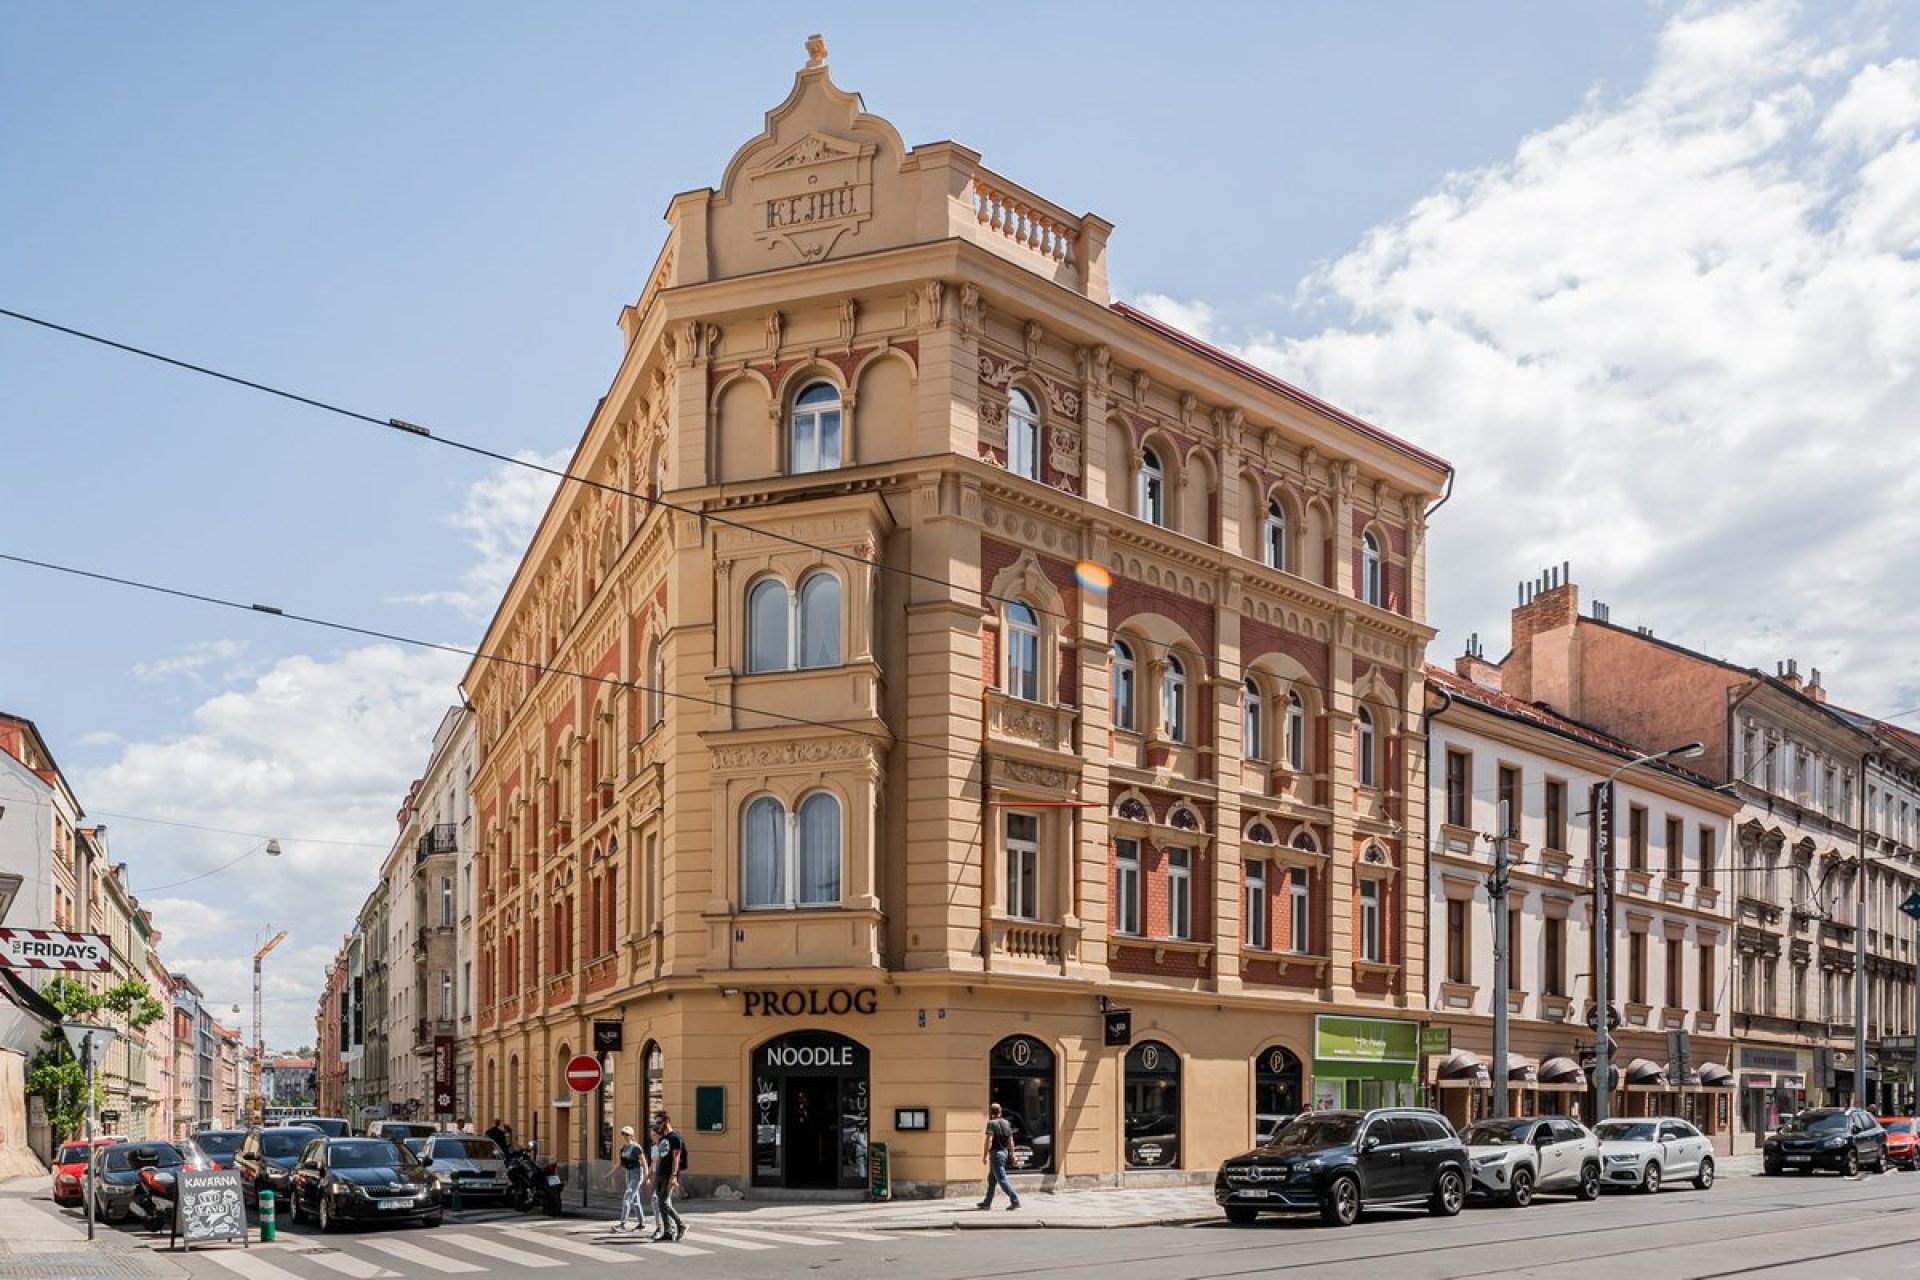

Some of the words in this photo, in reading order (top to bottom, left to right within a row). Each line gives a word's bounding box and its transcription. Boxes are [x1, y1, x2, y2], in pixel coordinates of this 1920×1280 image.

[23, 942, 97, 959] FRIDAYS
[743, 988, 877, 1016] PROLOG
[767, 1047, 853, 1066] NOODLE
[758, 1077, 773, 1125] WOK
